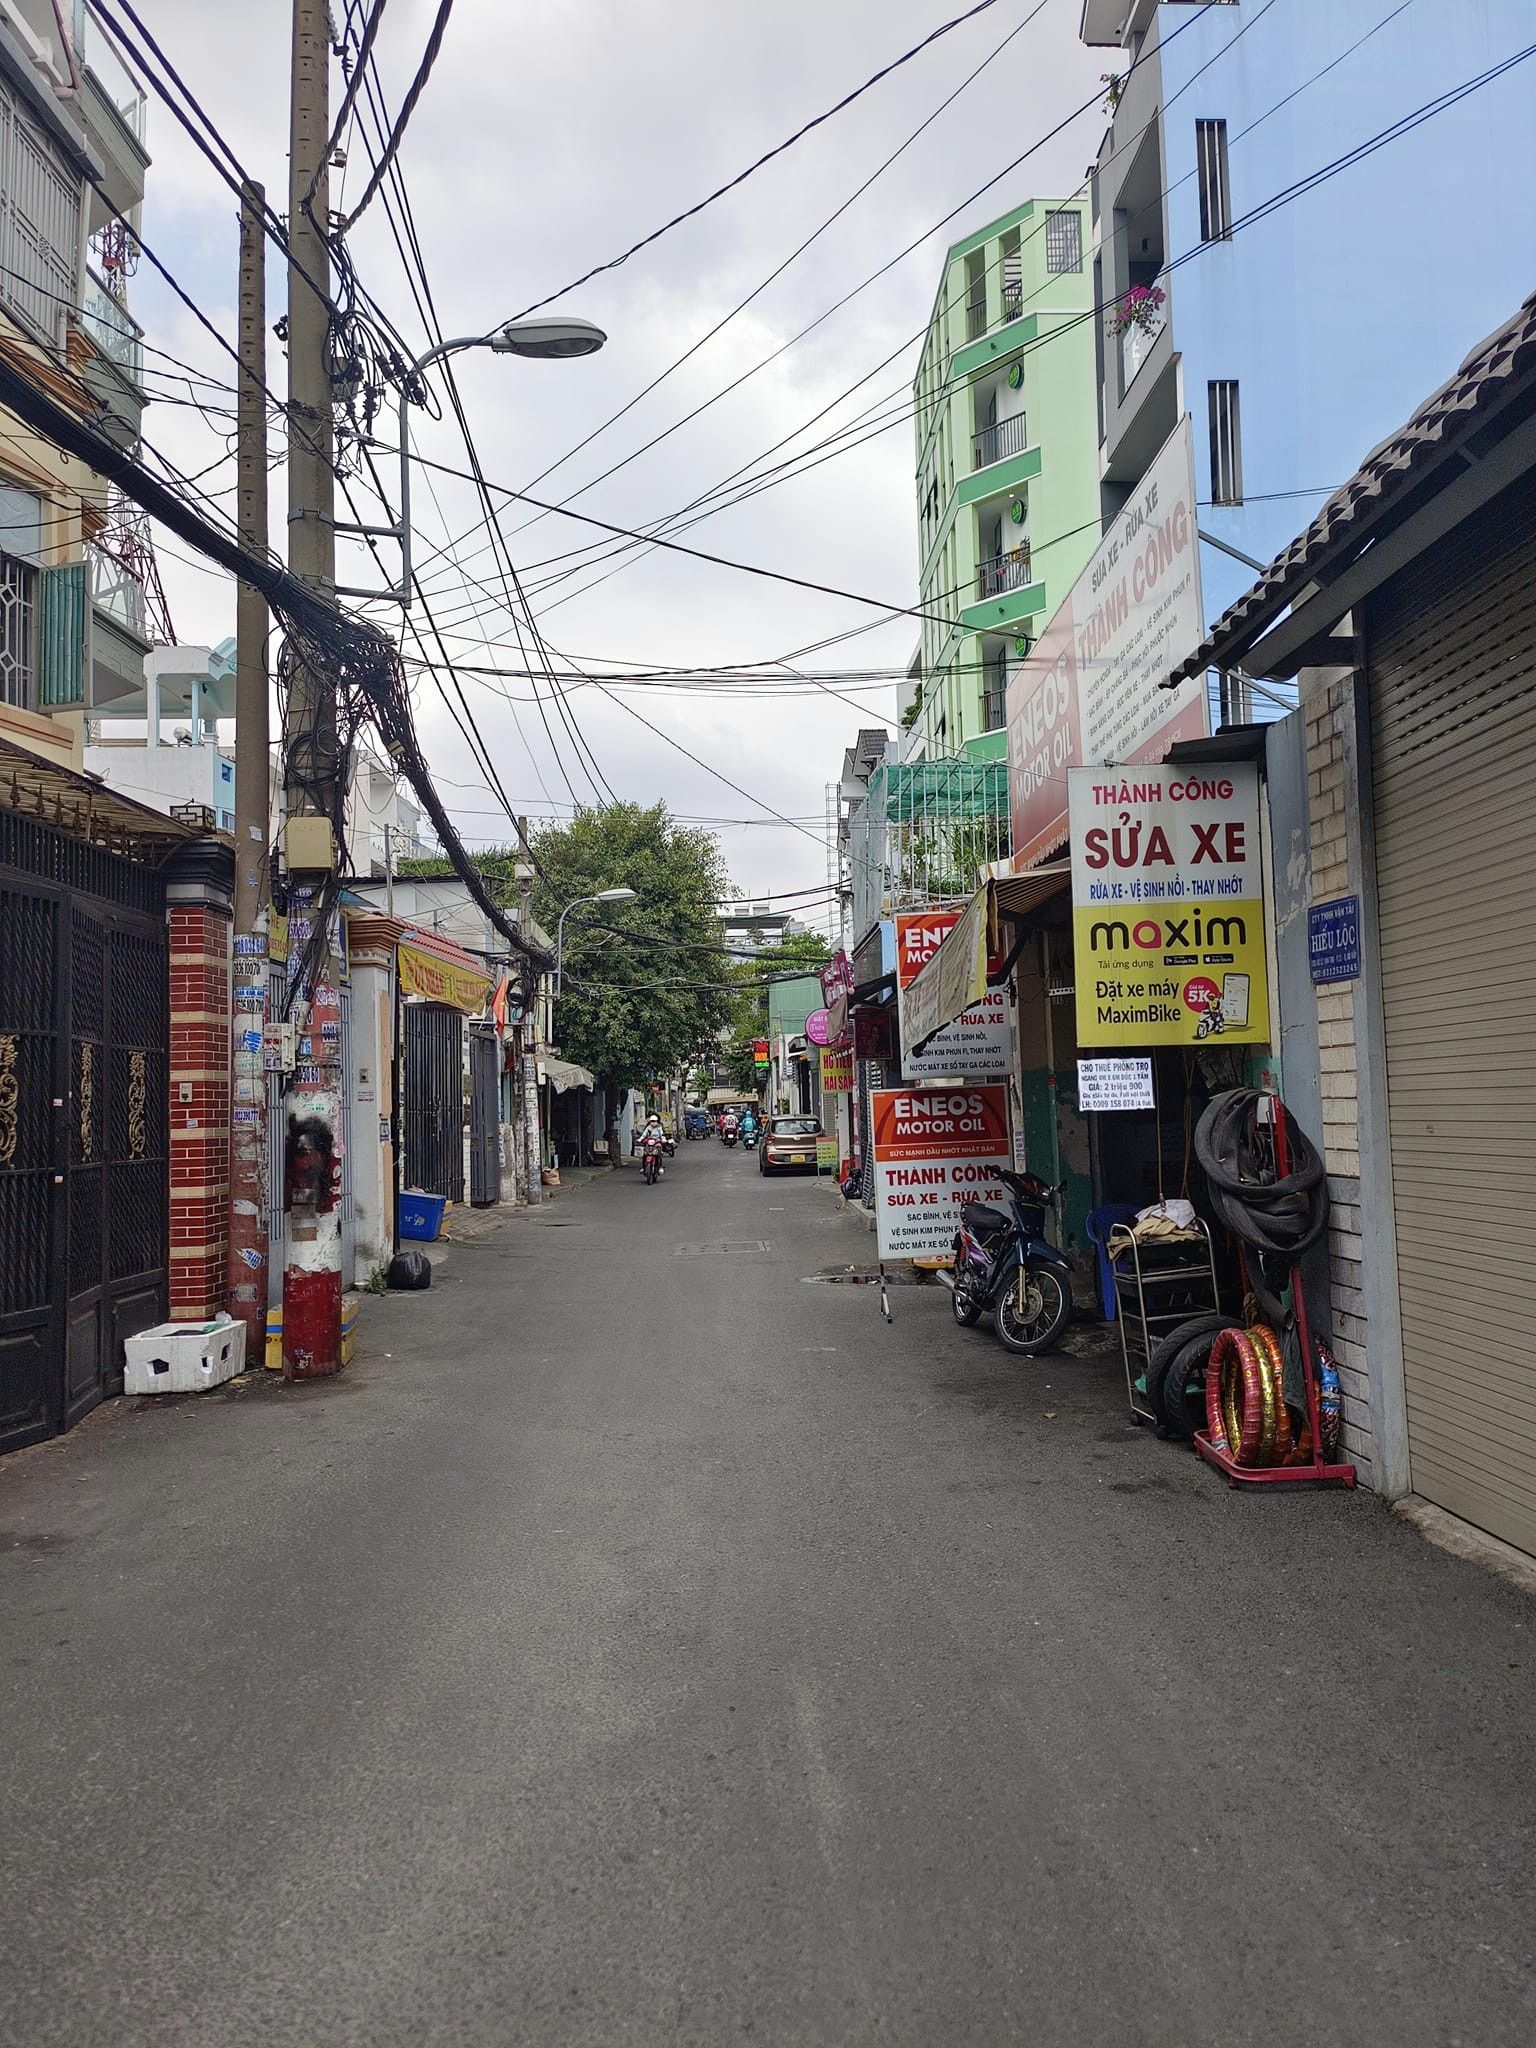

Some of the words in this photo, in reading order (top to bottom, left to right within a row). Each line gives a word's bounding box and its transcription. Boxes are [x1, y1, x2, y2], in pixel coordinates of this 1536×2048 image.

[1108, 538, 1119, 572] XE
[1145, 482, 1158, 518] XE
[1078, 575, 1129, 672] THÀNH
[1132, 500, 1188, 603] CÔNG
[1010, 655, 1070, 770] ENEOS
[1015, 747, 1051, 811] MOTOR
[1053, 721, 1073, 769] OIL
[1092, 779, 1162, 805] THÀNH
[1169, 776, 1234, 801] CÔNG
[1085, 811, 1175, 869] SỬA
[1190, 822, 1246, 865] XE
[1090, 879, 1109, 900] RỬA
[1111, 883, 1123, 899] XE
[1130, 878, 1142, 902] VỆ
[1143, 881, 1165, 897] SINH
[1168, 873, 1185, 896] NỒI
[1192, 880, 1215, 896] THAY
[1217, 874, 1243, 894] NHỚT
[1090, 908, 1246, 950] maxim
[1312, 923, 1334, 952] HIẾU
[1336, 923, 1355, 950] LỘC
[1098, 960, 1110, 969] Tải
[1112, 960, 1130, 970] ứng
[1132, 959, 1154, 970] dụng
[1096, 980, 1123, 1002] Đặt
[1127, 984, 1145, 998] xe
[1148, 978, 1180, 1000] máy
[1188, 989, 1210, 1003] 5K
[989, 1013, 1004, 1024] XE
[1097, 1004, 1181, 1024] MaximBike
[961, 1033, 974, 1041] SINH
[946, 1048, 962, 1056] PHUN
[970, 1047, 984, 1055] THAY
[985, 1045, 1001, 1054] NHỚT
[928, 1061, 940, 1071] MÁT
[941, 1062, 948, 1070] XE
[959, 1061, 968, 1069] TAY
[969, 1061, 978, 1069] GA
[978, 1060, 991, 1069] CÁC
[991, 1060, 1005, 1069] LOẠI
[1080, 1063, 1093, 1073] CHO
[1136, 1062, 1149, 1072] TRỌ
[1129, 1082, 1143, 1090] 900
[894, 1094, 984, 1119] ENEOS
[896, 1120, 954, 1135] MOTOR
[959, 1118, 985, 1132] OIL
[889, 1149, 904, 1157] SỨC
[905, 1149, 925, 1158] MẠNH
[927, 1146, 940, 1155] DẦU
[886, 1166, 946, 1186] THÀNH
[887, 1191, 915, 1206] SỬA
[920, 1193, 938, 1205] XE
[984, 1189, 1003, 1201] XE
[907, 1212, 921, 1223] SẠC
[892, 1228, 901, 1238] VỆ
[902, 1227, 918, 1236] SINH
[920, 1227, 933, 1235] KIM
[934, 1226, 953, 1234] PHUN
[889, 1241, 911, 1250] NƯỚC
[912, 1240, 927, 1249] MÁT
[938, 1238, 949, 1248] SỐ
